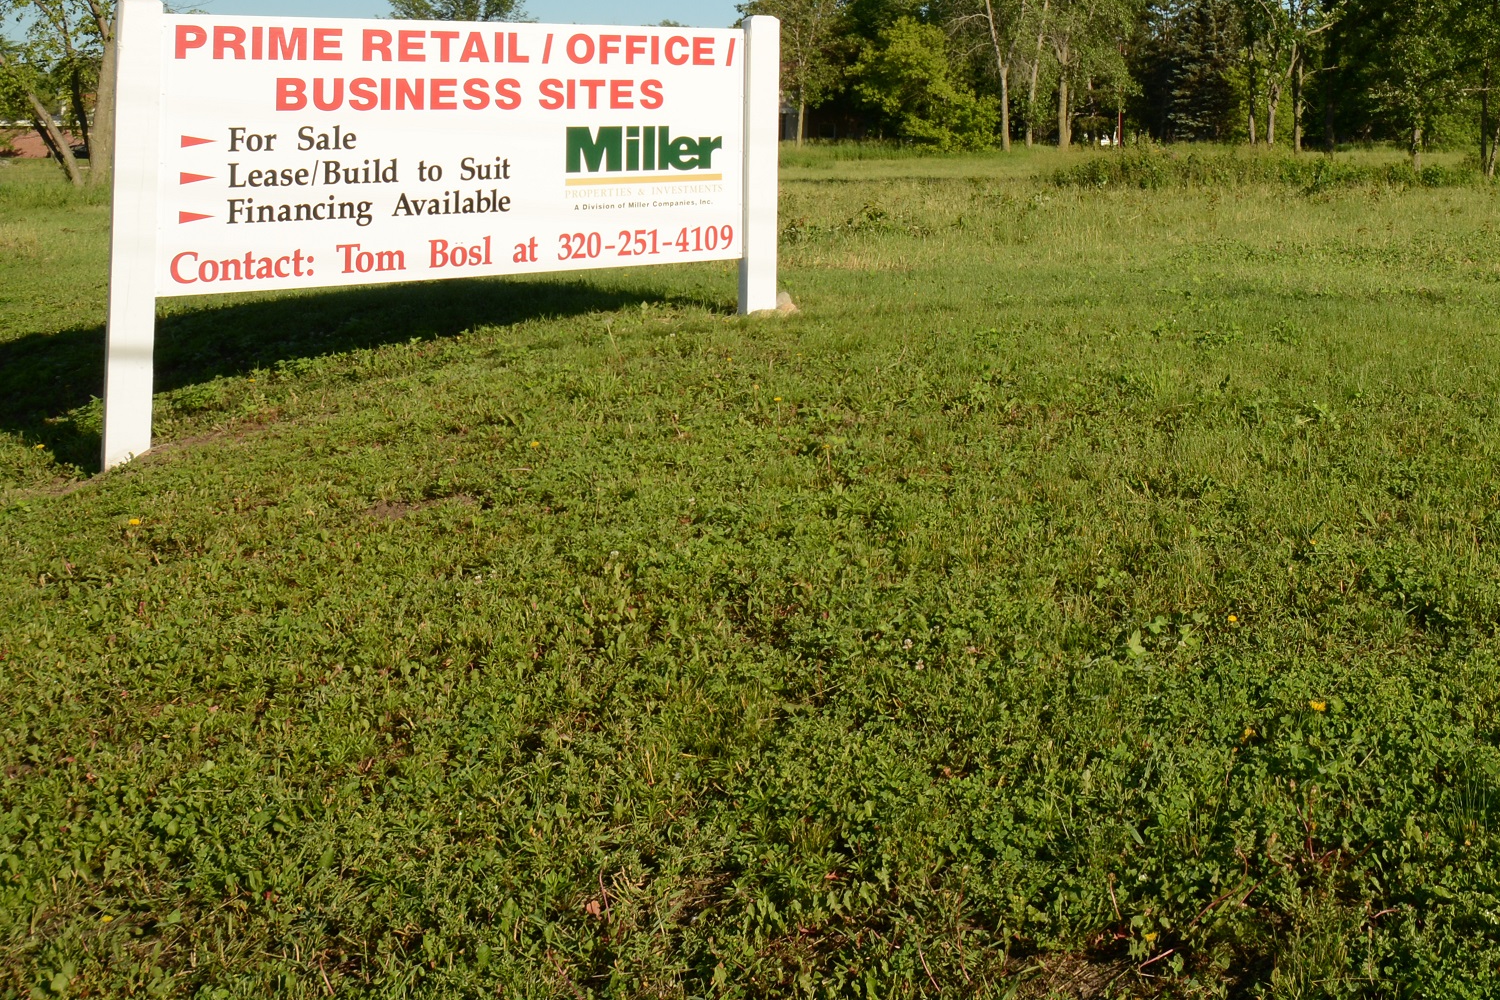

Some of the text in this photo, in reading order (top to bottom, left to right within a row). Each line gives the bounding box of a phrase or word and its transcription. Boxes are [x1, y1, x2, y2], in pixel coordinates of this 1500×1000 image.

[174, 24, 736, 67] PRIME RETAIL / OFFICE /
[275, 76, 664, 112] BUSINESS SITES
[227, 124, 357, 153] For Sale
[565, 125, 723, 174] Miller
[227, 155, 511, 189] Lease/Build to Suit
[226, 188, 511, 227] Financing Available
[564, 183, 723, 199] PROPERTIES & INVESTMENTS
[582, 203, 615, 211] Division
[652, 200, 698, 208] Companies,
[169, 248, 315, 285] Contact:
[335, 243, 407, 274] Tom
[512, 236, 539, 264] at
[557, 224, 734, 261] 320-251-4109
